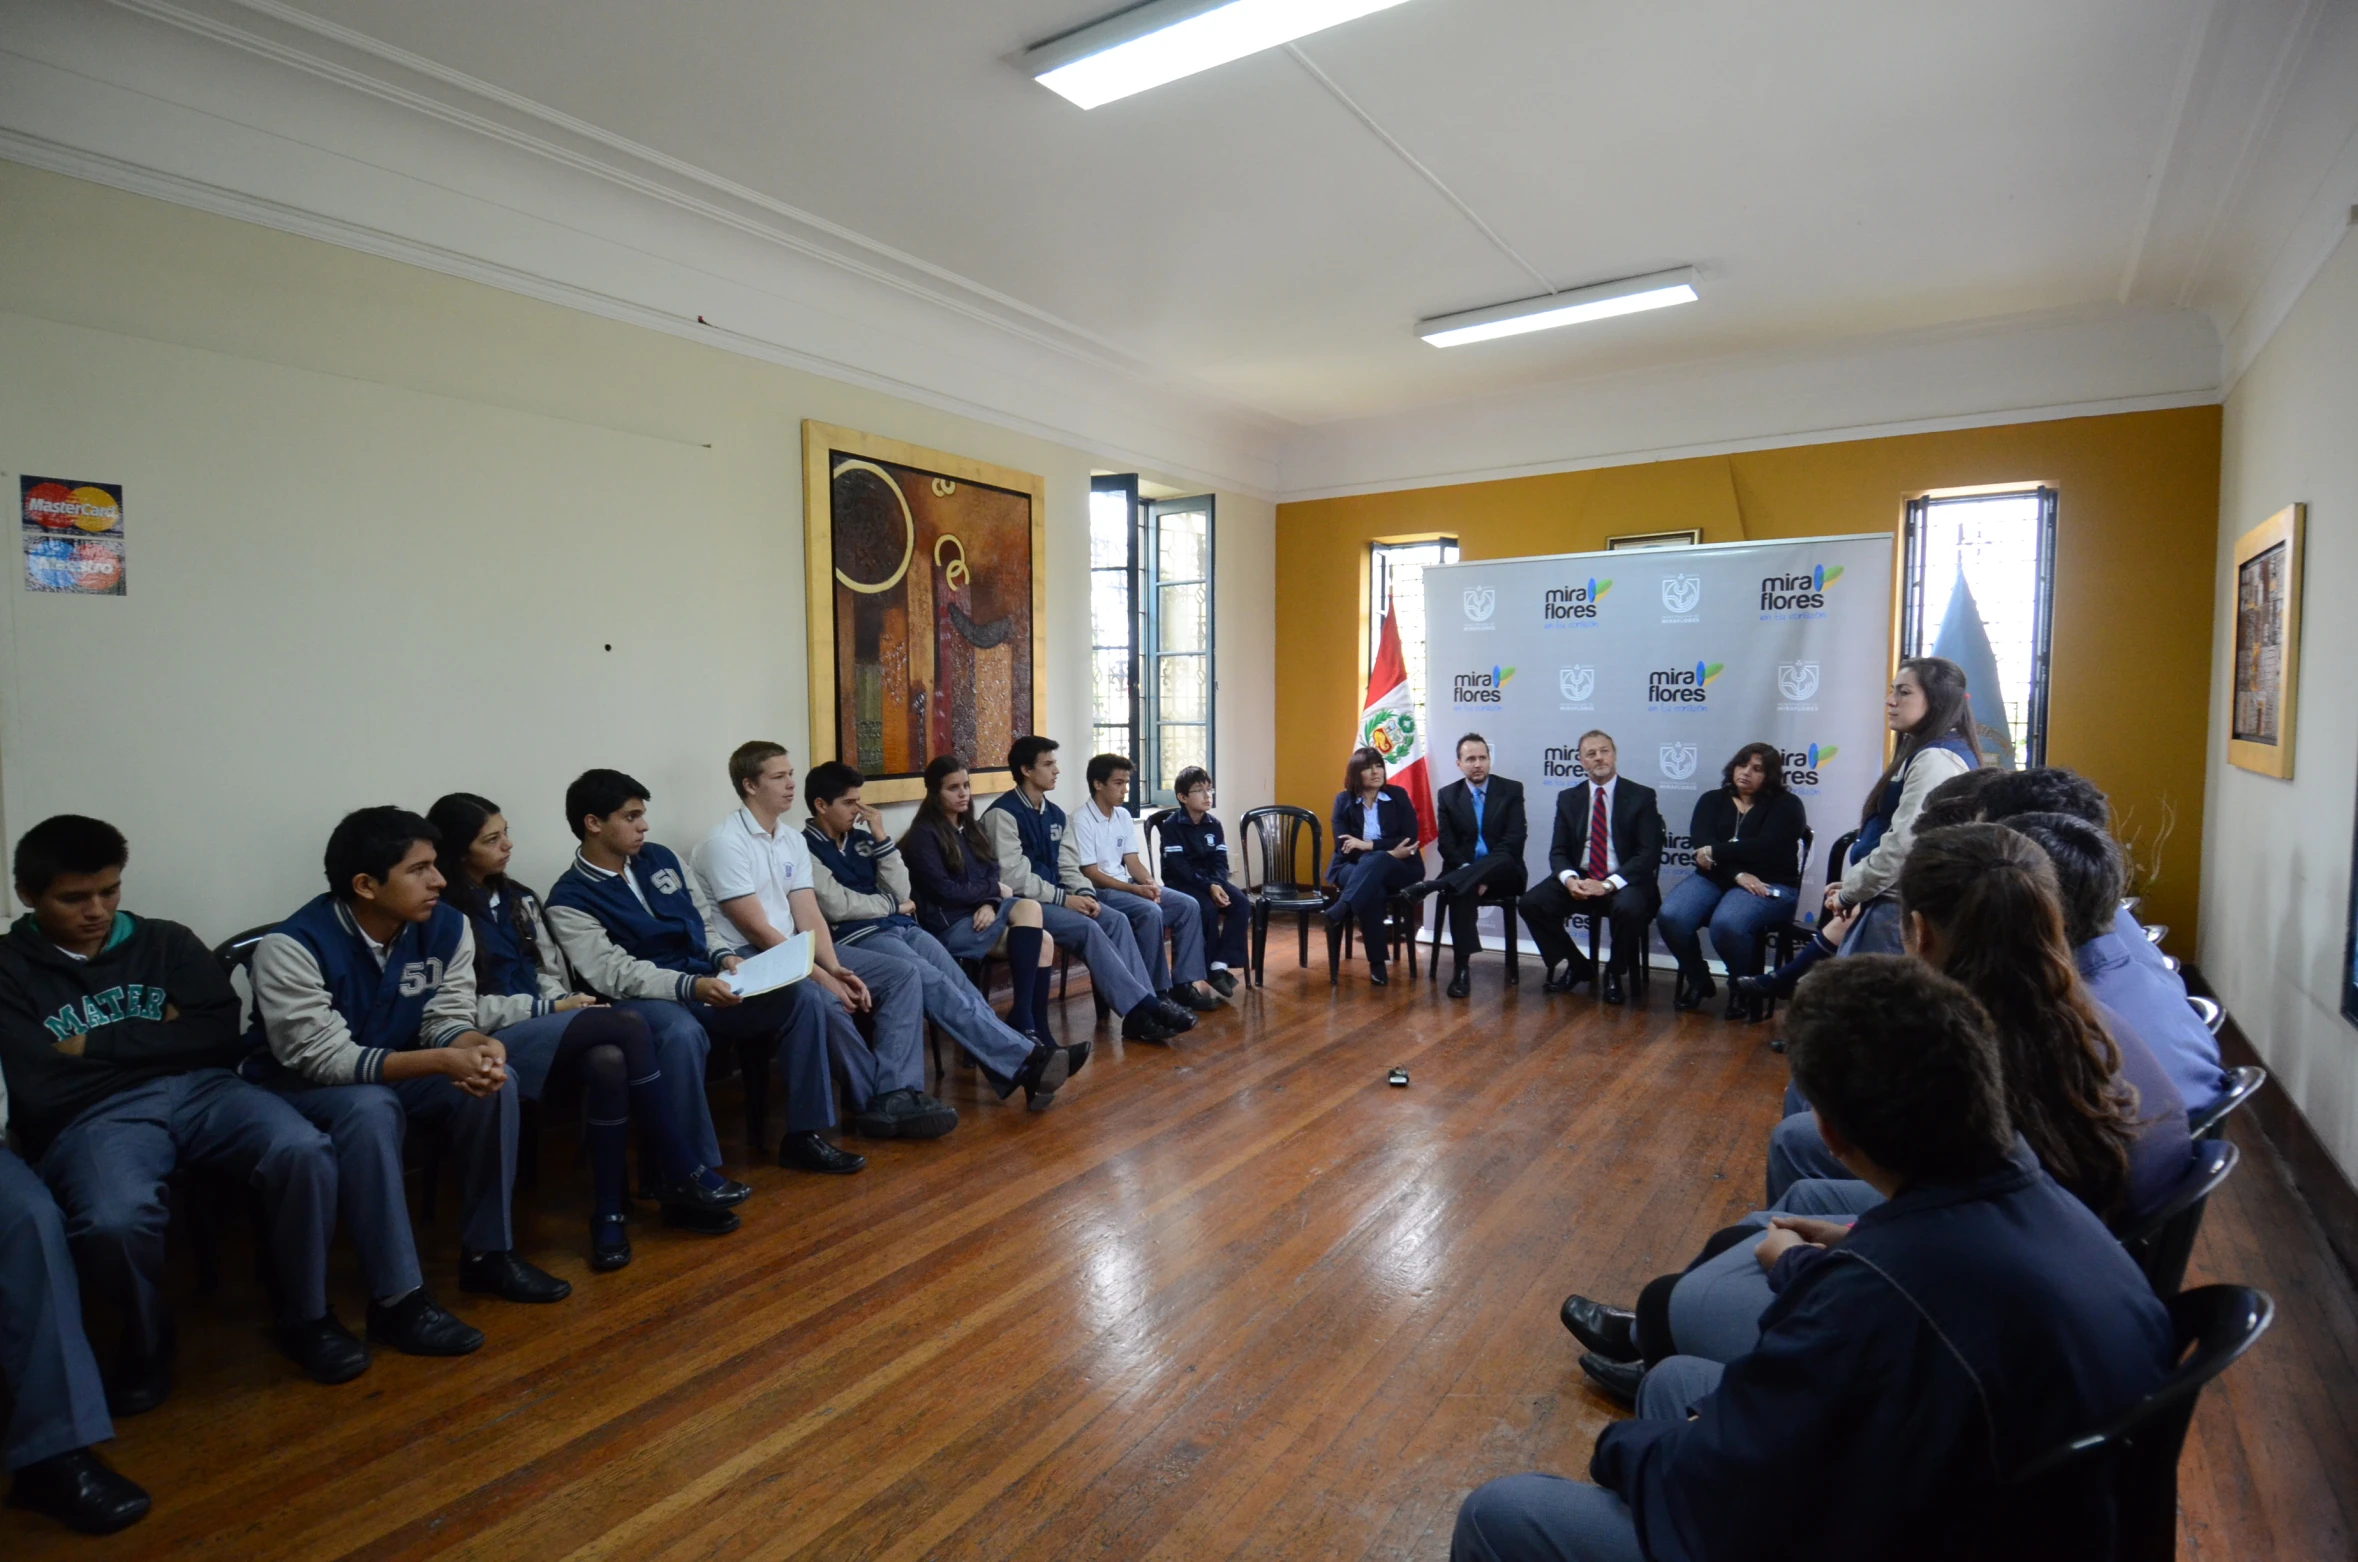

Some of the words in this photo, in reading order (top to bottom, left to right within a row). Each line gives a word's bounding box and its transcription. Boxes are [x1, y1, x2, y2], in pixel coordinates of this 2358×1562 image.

[29, 498, 116, 518] MasterCard
[1761, 573, 1812, 592] mira
[1545, 585, 1587, 603] mira
[1760, 592, 1824, 610] flores
[1544, 602, 1597, 619] flores
[1454, 672, 1492, 687] mira
[1649, 668, 1695, 685] mira
[1453, 687, 1501, 702] flores
[1648, 685, 1706, 702] flores
[1544, 745, 1579, 761] mir
[1780, 749, 1807, 767] ira
[1665, 831, 1692, 850] ira
[43, 984, 166, 1041] MATER
